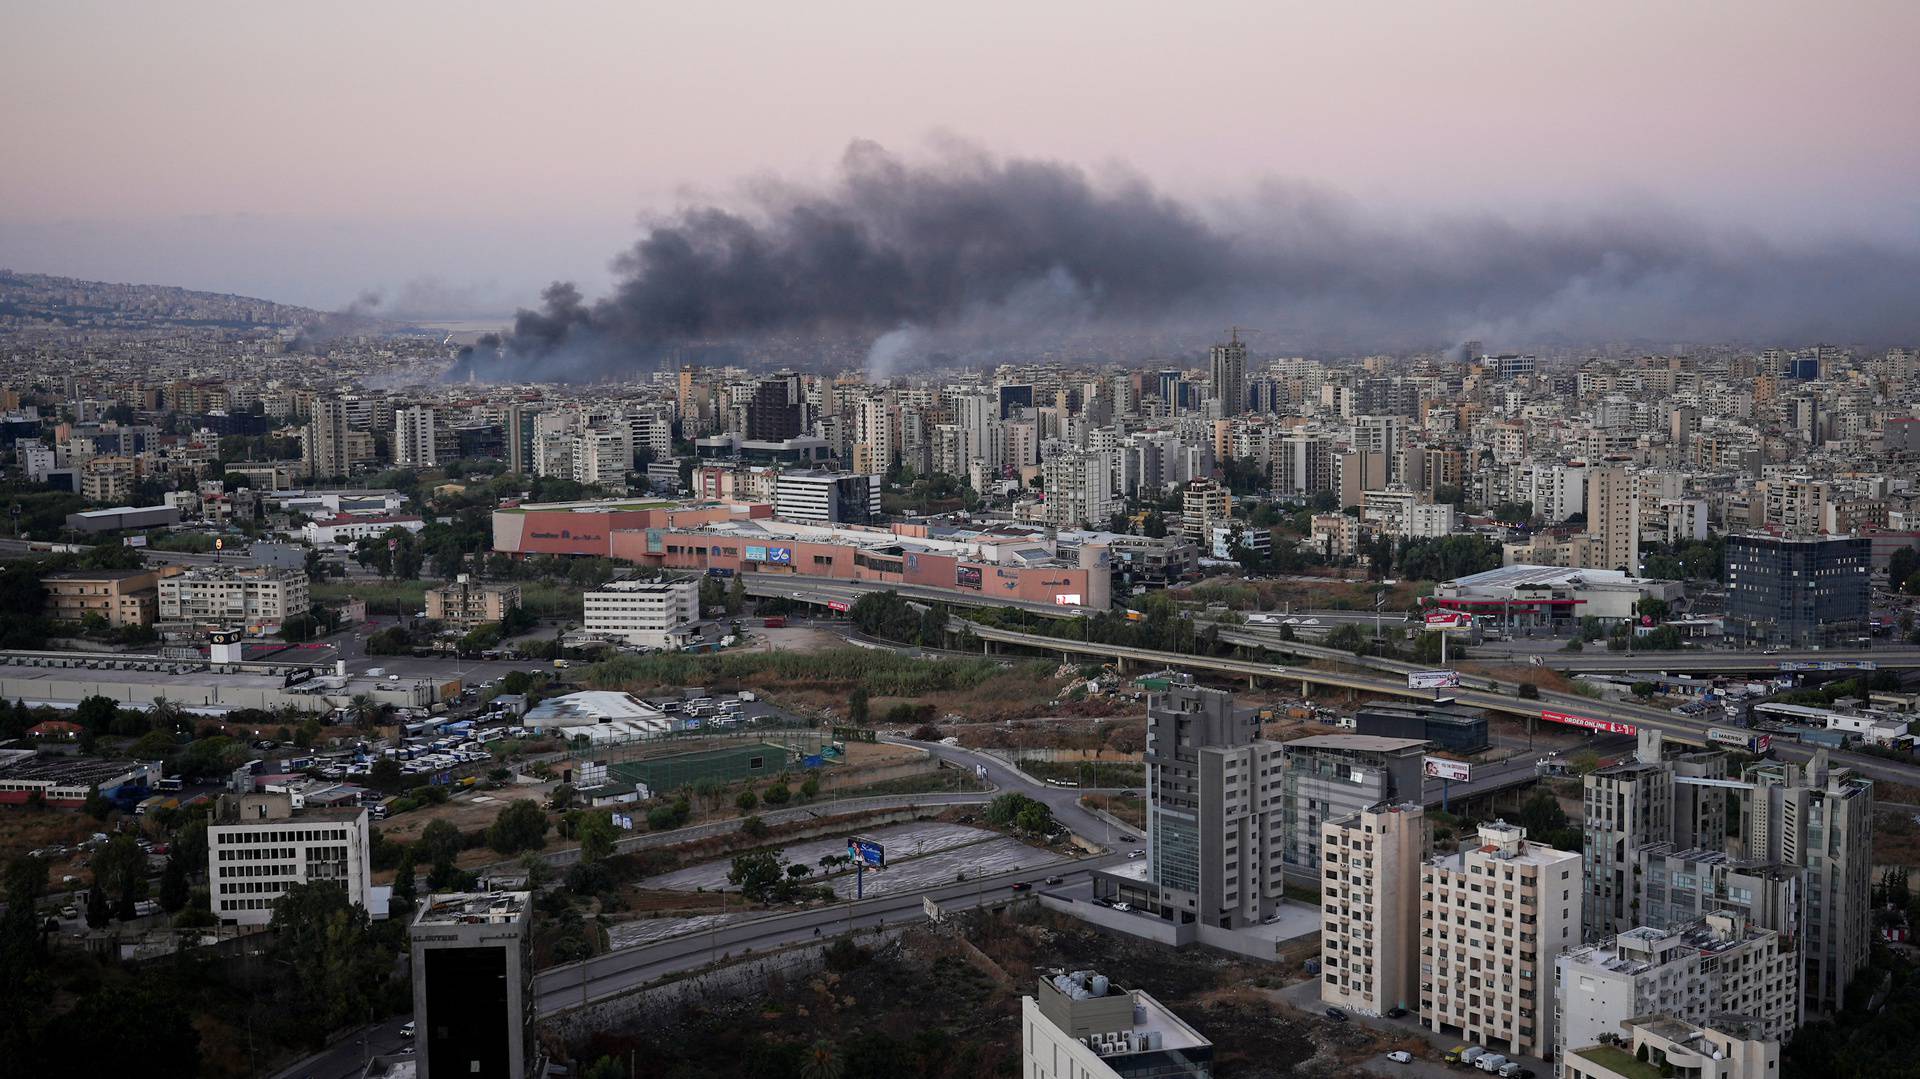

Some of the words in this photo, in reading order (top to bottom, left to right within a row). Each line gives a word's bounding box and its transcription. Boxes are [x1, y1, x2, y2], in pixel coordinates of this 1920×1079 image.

[1564, 717, 1584, 725] ORDER
[1585, 720, 1607, 730] ONLINE
[1719, 733, 1744, 743] MAERSK
